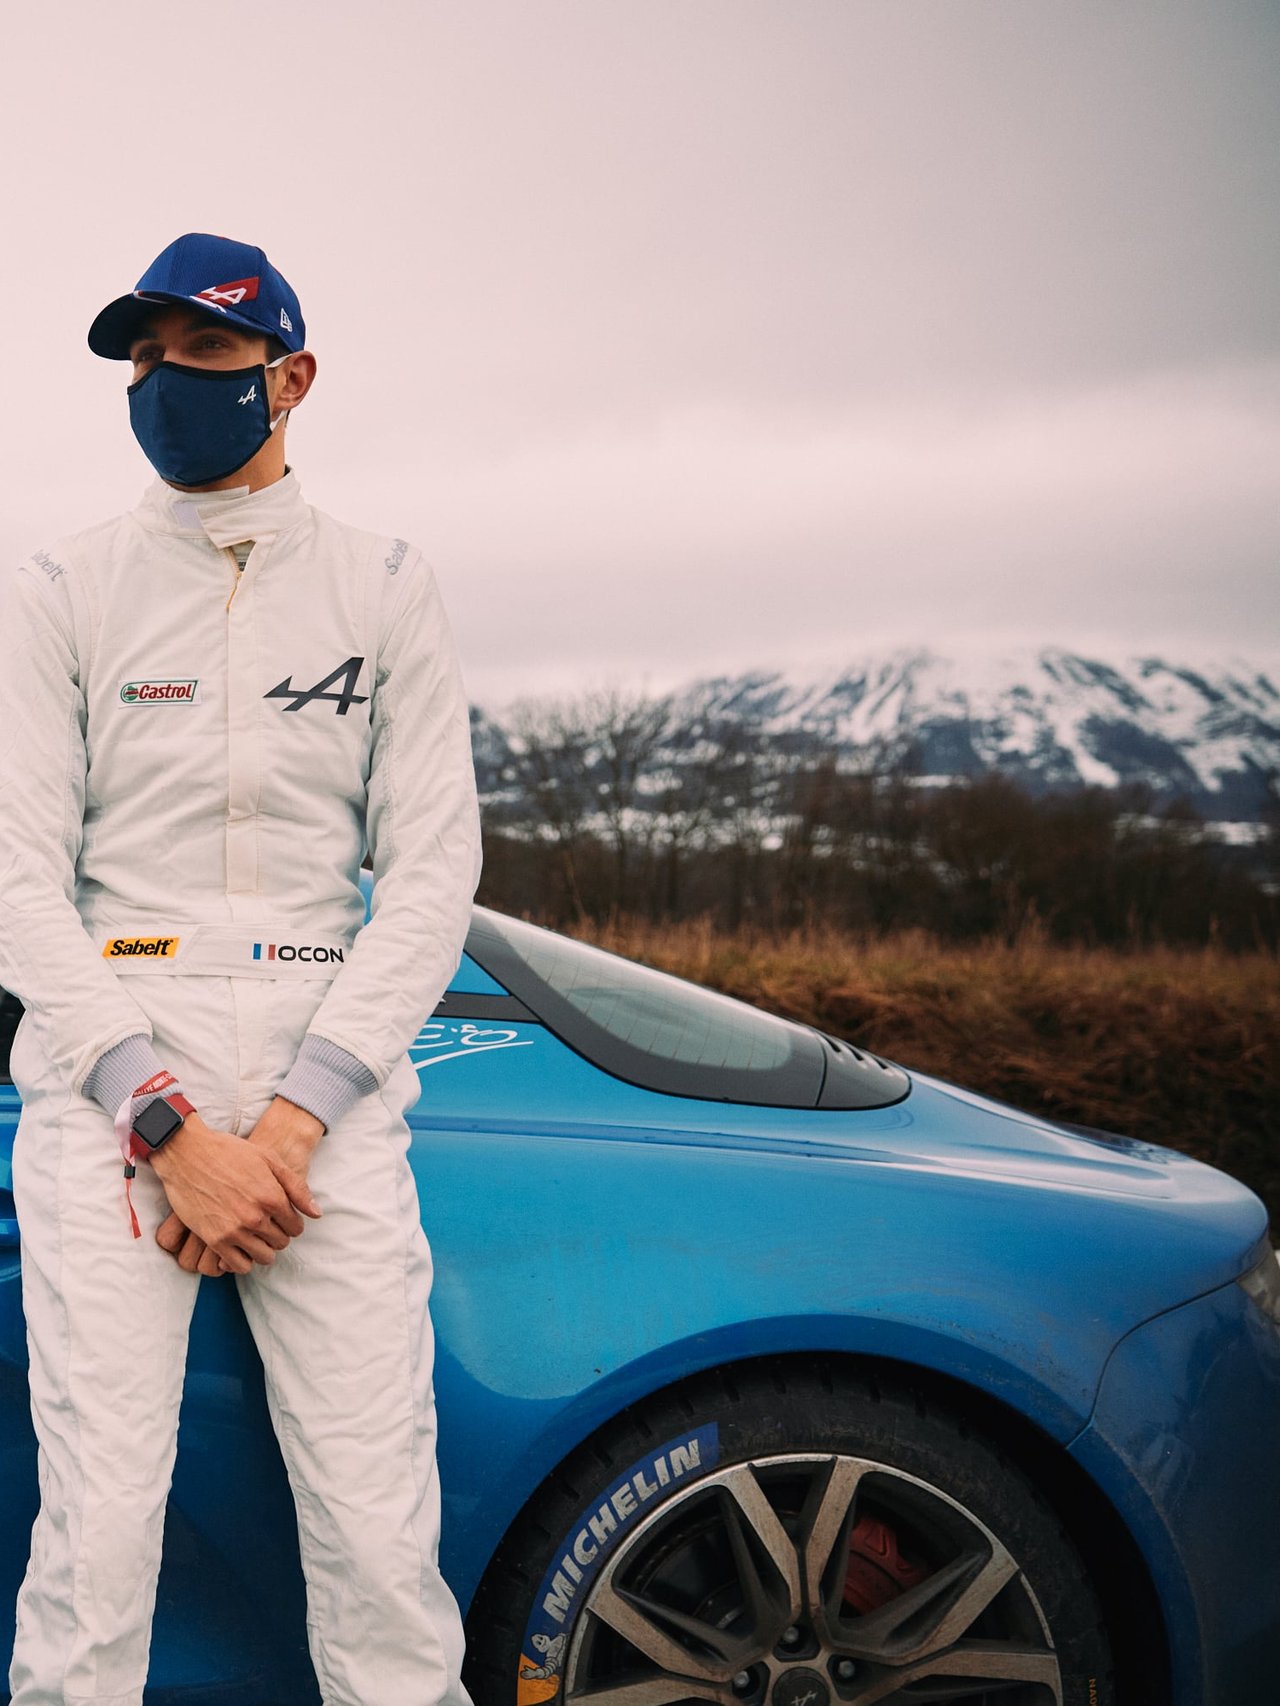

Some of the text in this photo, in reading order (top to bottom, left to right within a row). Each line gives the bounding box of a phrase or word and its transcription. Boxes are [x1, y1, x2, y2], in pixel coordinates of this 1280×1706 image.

[138, 683, 192, 700] Castrol
[110, 939, 171, 956] Sabelt
[277, 945, 345, 963] OCON
[541, 1438, 702, 1624] MICHELIN
